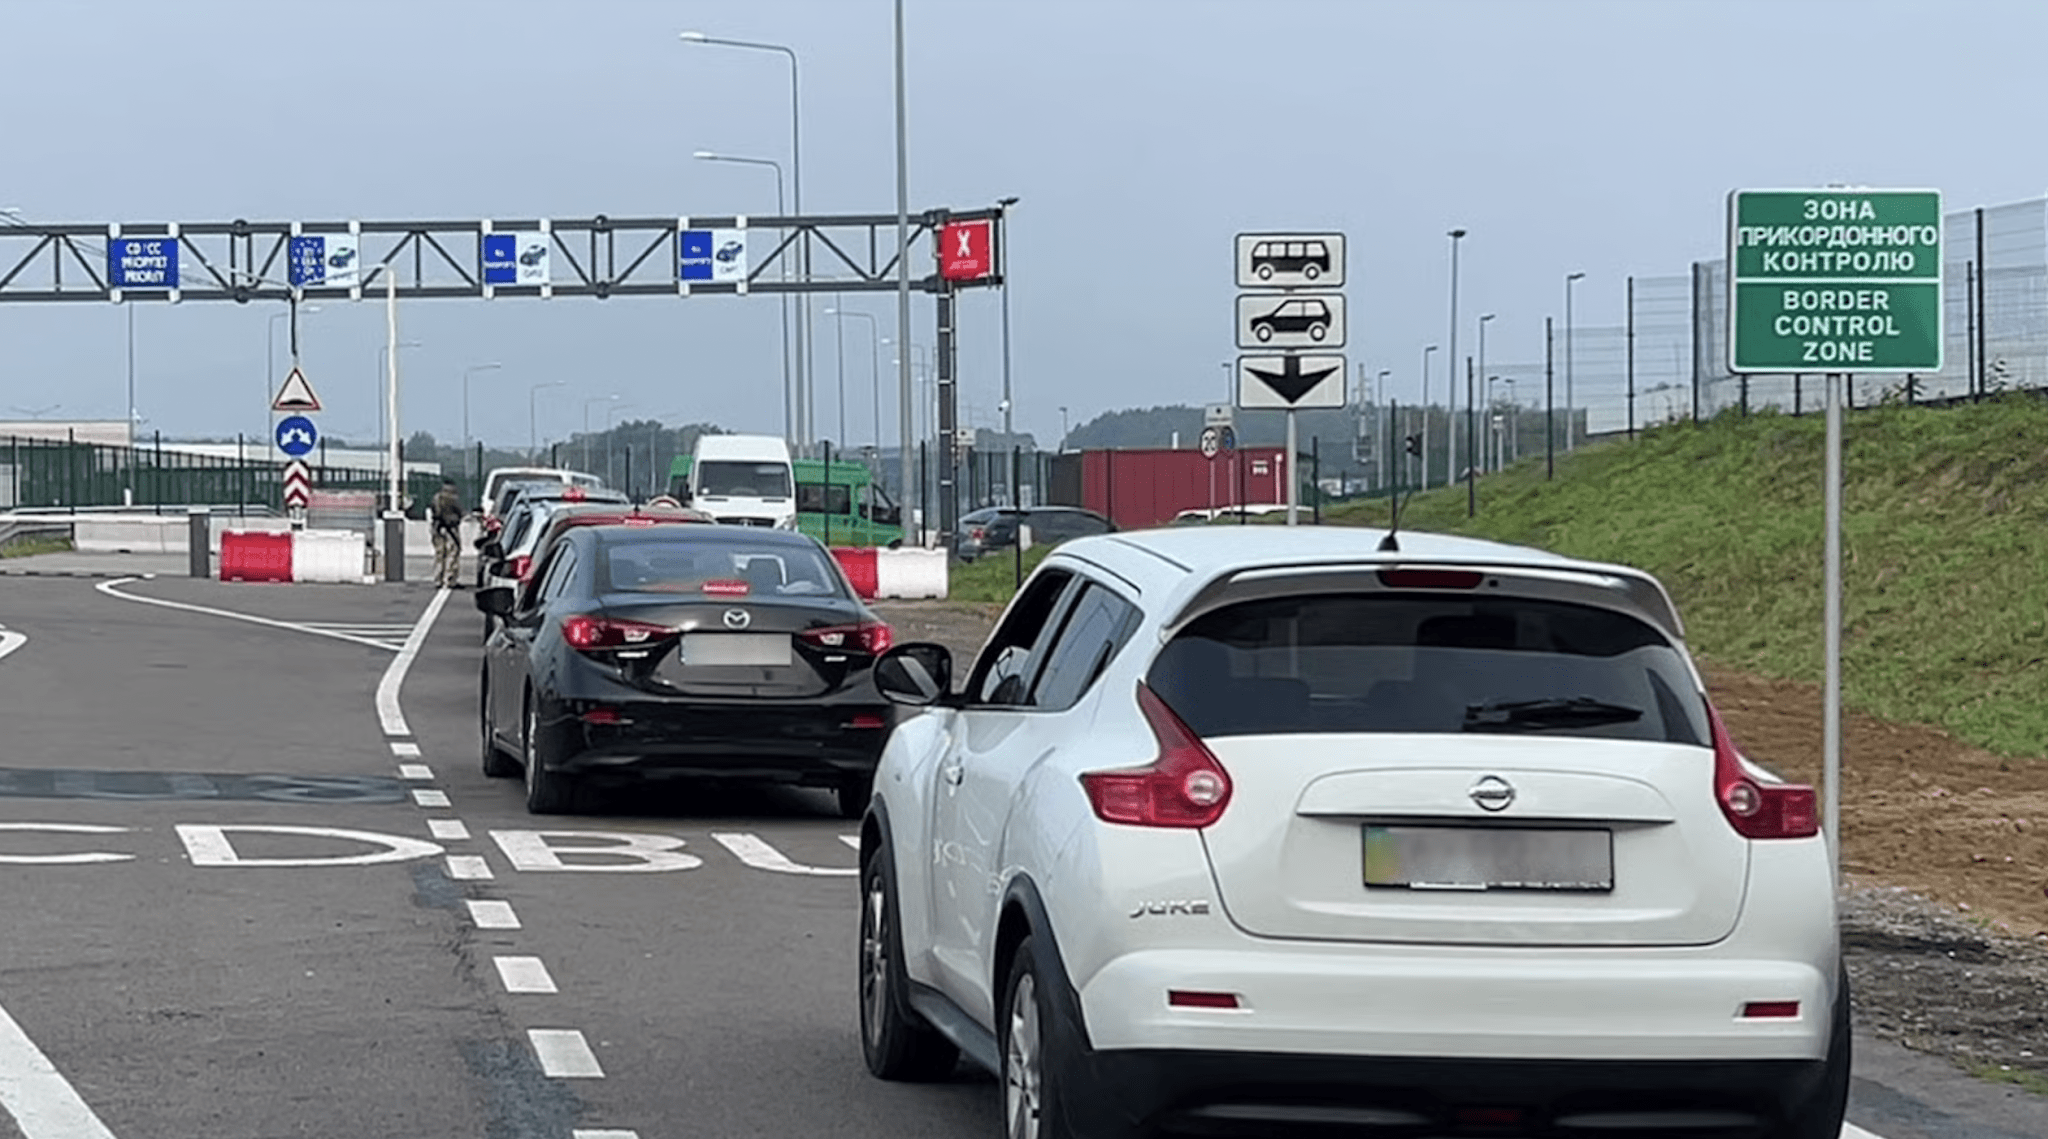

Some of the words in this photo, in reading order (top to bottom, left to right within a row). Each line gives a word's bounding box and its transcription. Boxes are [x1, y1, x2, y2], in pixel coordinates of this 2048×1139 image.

[1803, 199, 1876, 220] ЗОНА
[1738, 225, 1938, 249] ПРИКОРДОННОГО
[1763, 251, 1915, 271] КОНТРОЛЮ
[1783, 290, 1890, 310] BORDER
[1774, 315, 1900, 336] CONTROL
[1803, 341, 1874, 361] ZONE
[1129, 901, 1209, 919] JUKE
